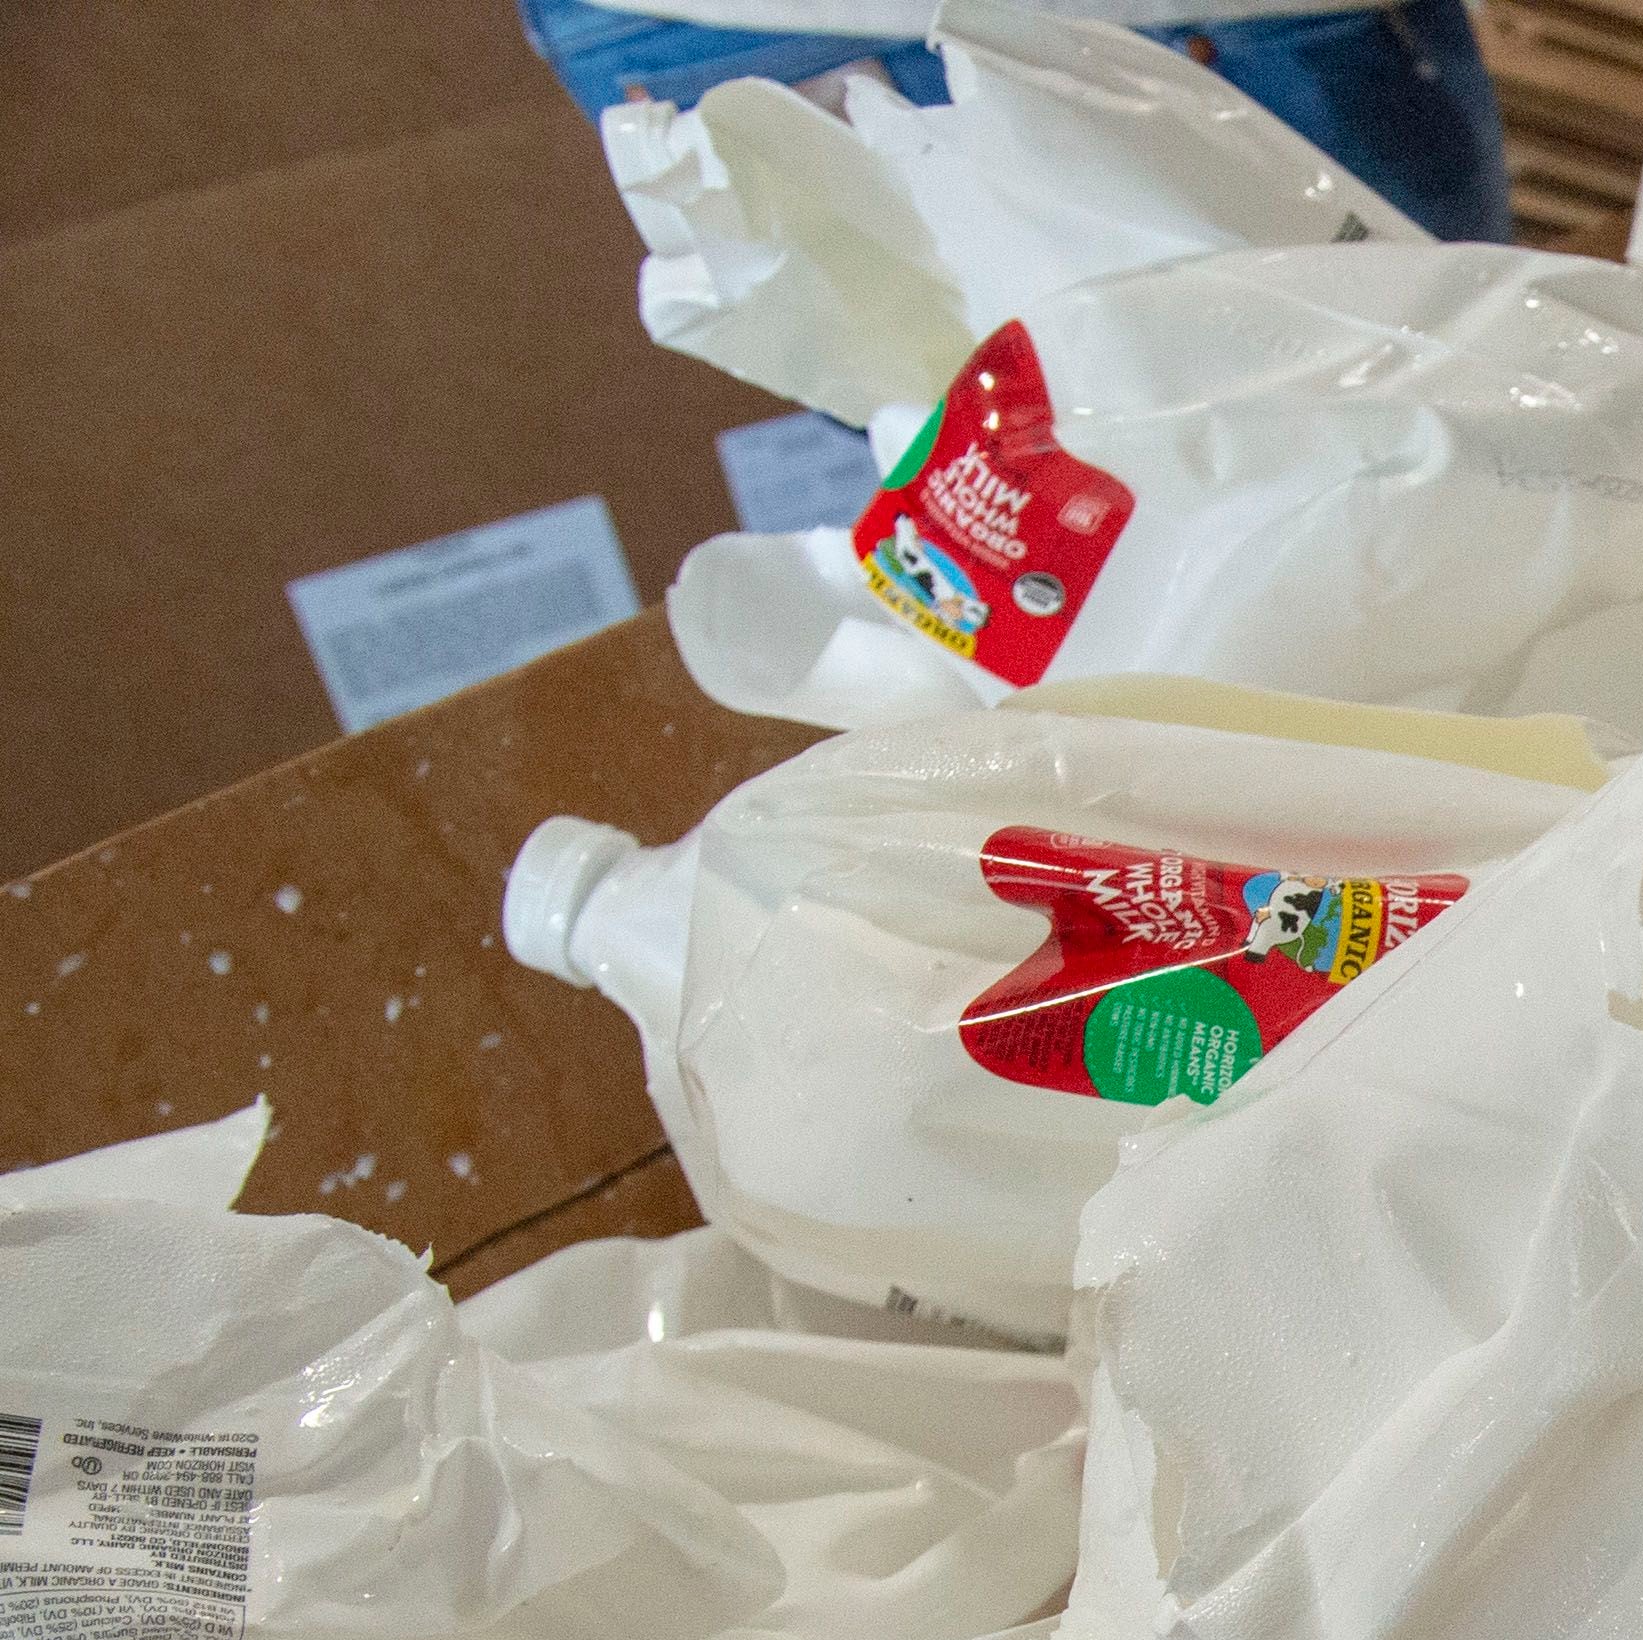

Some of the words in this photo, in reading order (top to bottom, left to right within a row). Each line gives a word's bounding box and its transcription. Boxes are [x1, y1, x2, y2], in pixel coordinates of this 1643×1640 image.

[1082, 867, 1153, 945] MILK
[1126, 862, 1173, 946] WHOLE
[1372, 876, 1421, 954] ORIZ
[1199, 1023, 1223, 1094] ORGANIC
[146, 1445, 175, 1457] KEEP
[188, 1443, 257, 1458] PERISHABLE
[228, 1460, 255, 1471] VISIT
[76, 1479, 108, 1491] DAYS
[121, 1483, 162, 1494] WITHIN
[164, 1484, 195, 1496] USED
[198, 1487, 222, 1497] AND
[223, 1488, 253, 1499] DATE
